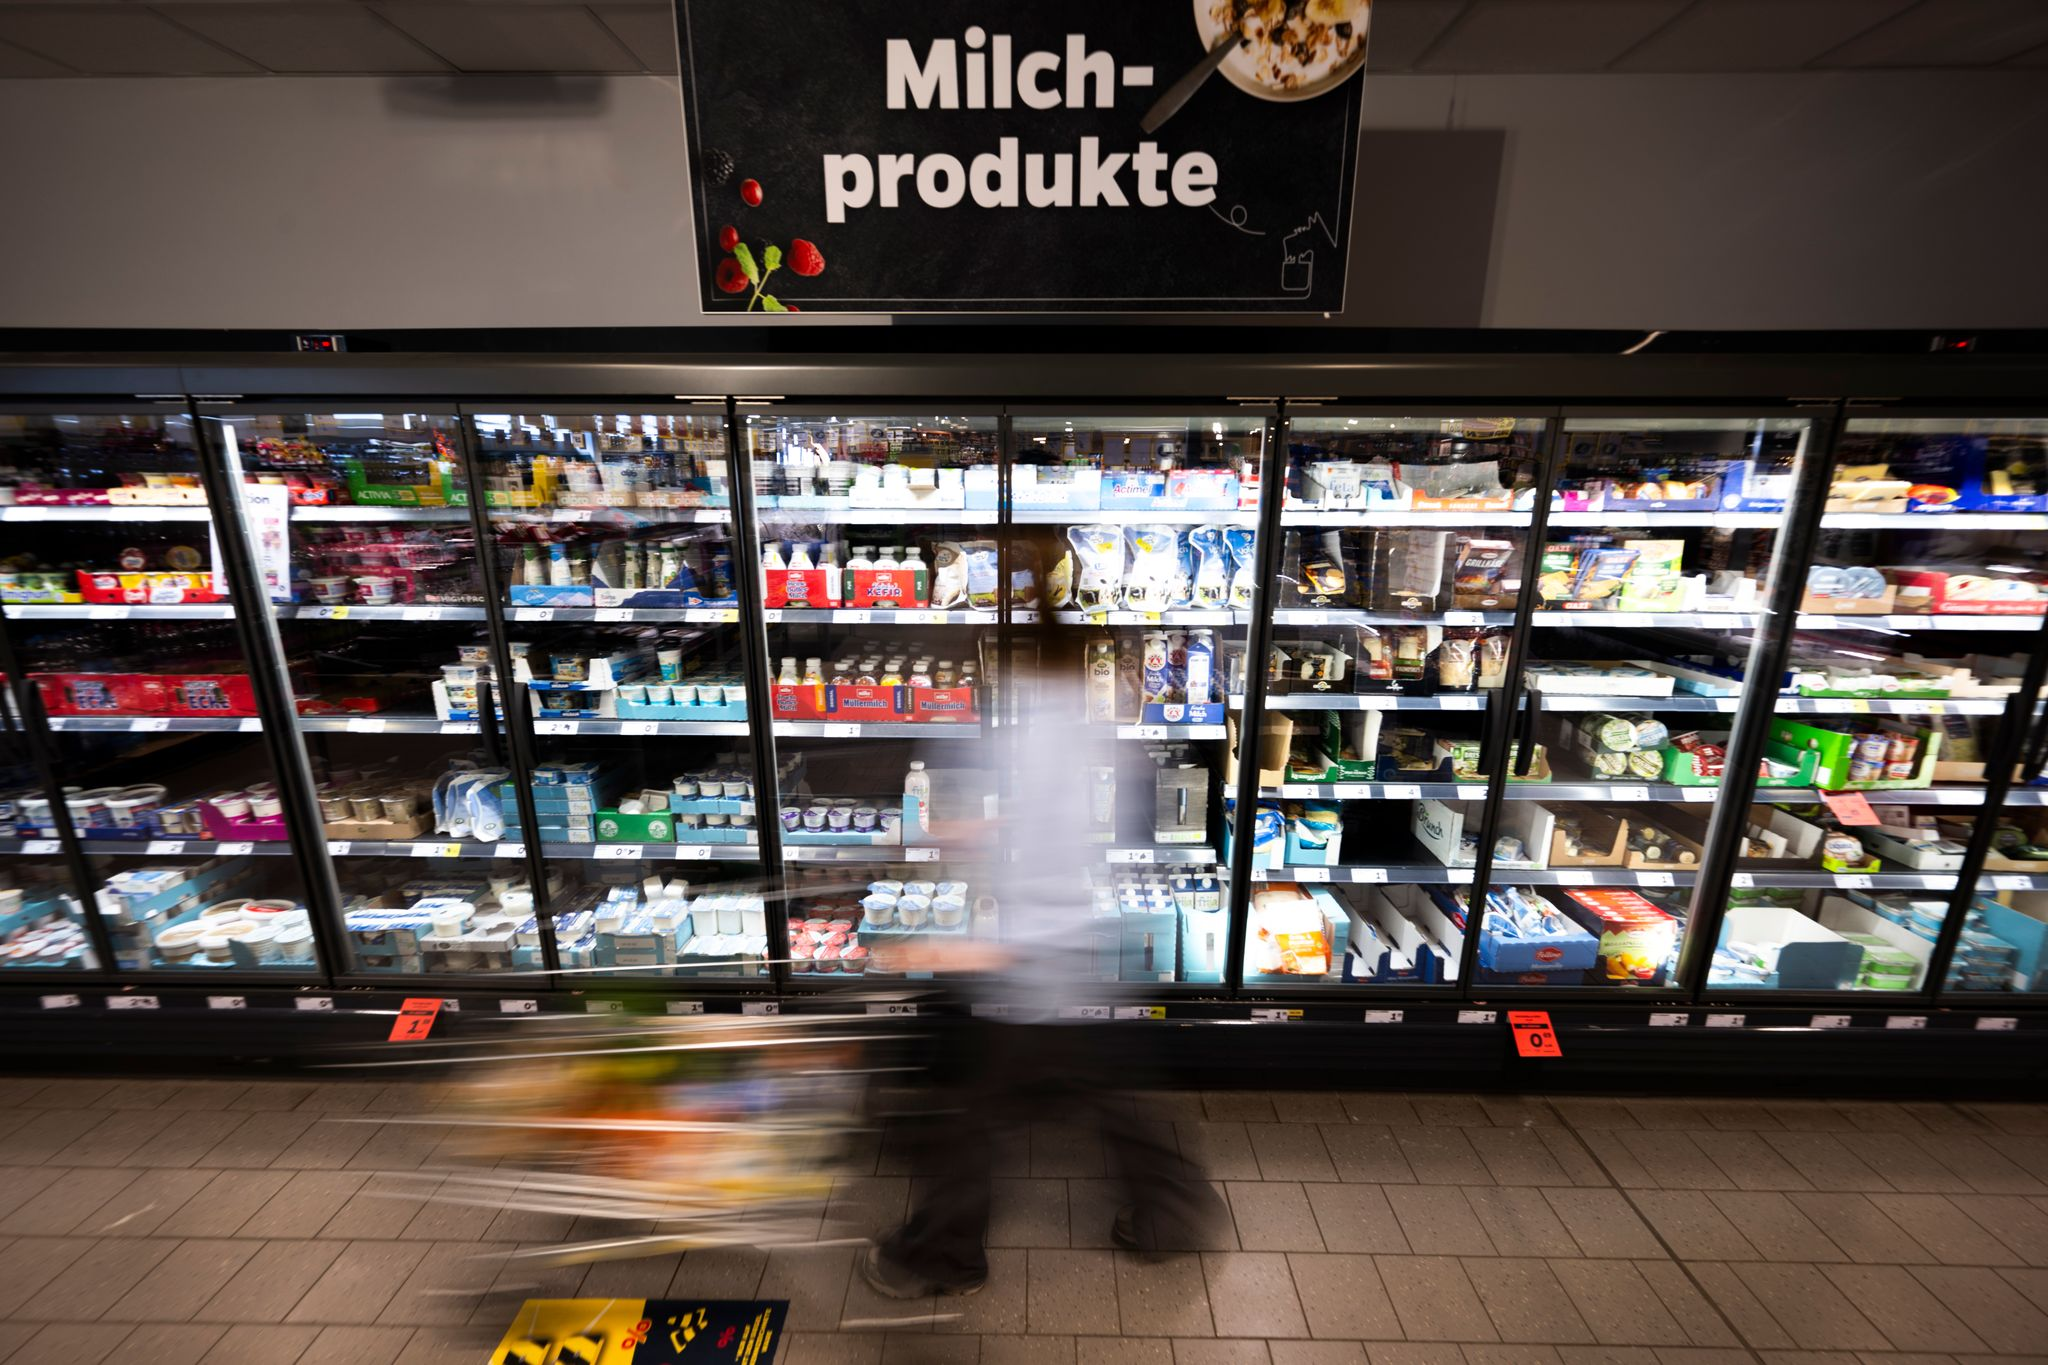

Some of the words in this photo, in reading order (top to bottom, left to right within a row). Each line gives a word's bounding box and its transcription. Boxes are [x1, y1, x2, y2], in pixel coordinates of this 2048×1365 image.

[886, 25, 1155, 110] Milch-
[823, 136, 1219, 224] produkte
[357, 489, 392, 500] ACTIVIA
[1113, 483, 1152, 495] Actimel
[866, 588, 902, 597] KEFIR
[1094, 667, 1110, 676] bio
[842, 698, 888, 708] Müllermilch
[920, 701, 966, 711] Müllermilch
[1417, 802, 1444, 838] Brunch
[407, 1020, 419, 1034] 1
[1530, 1033, 1543, 1048] 0
